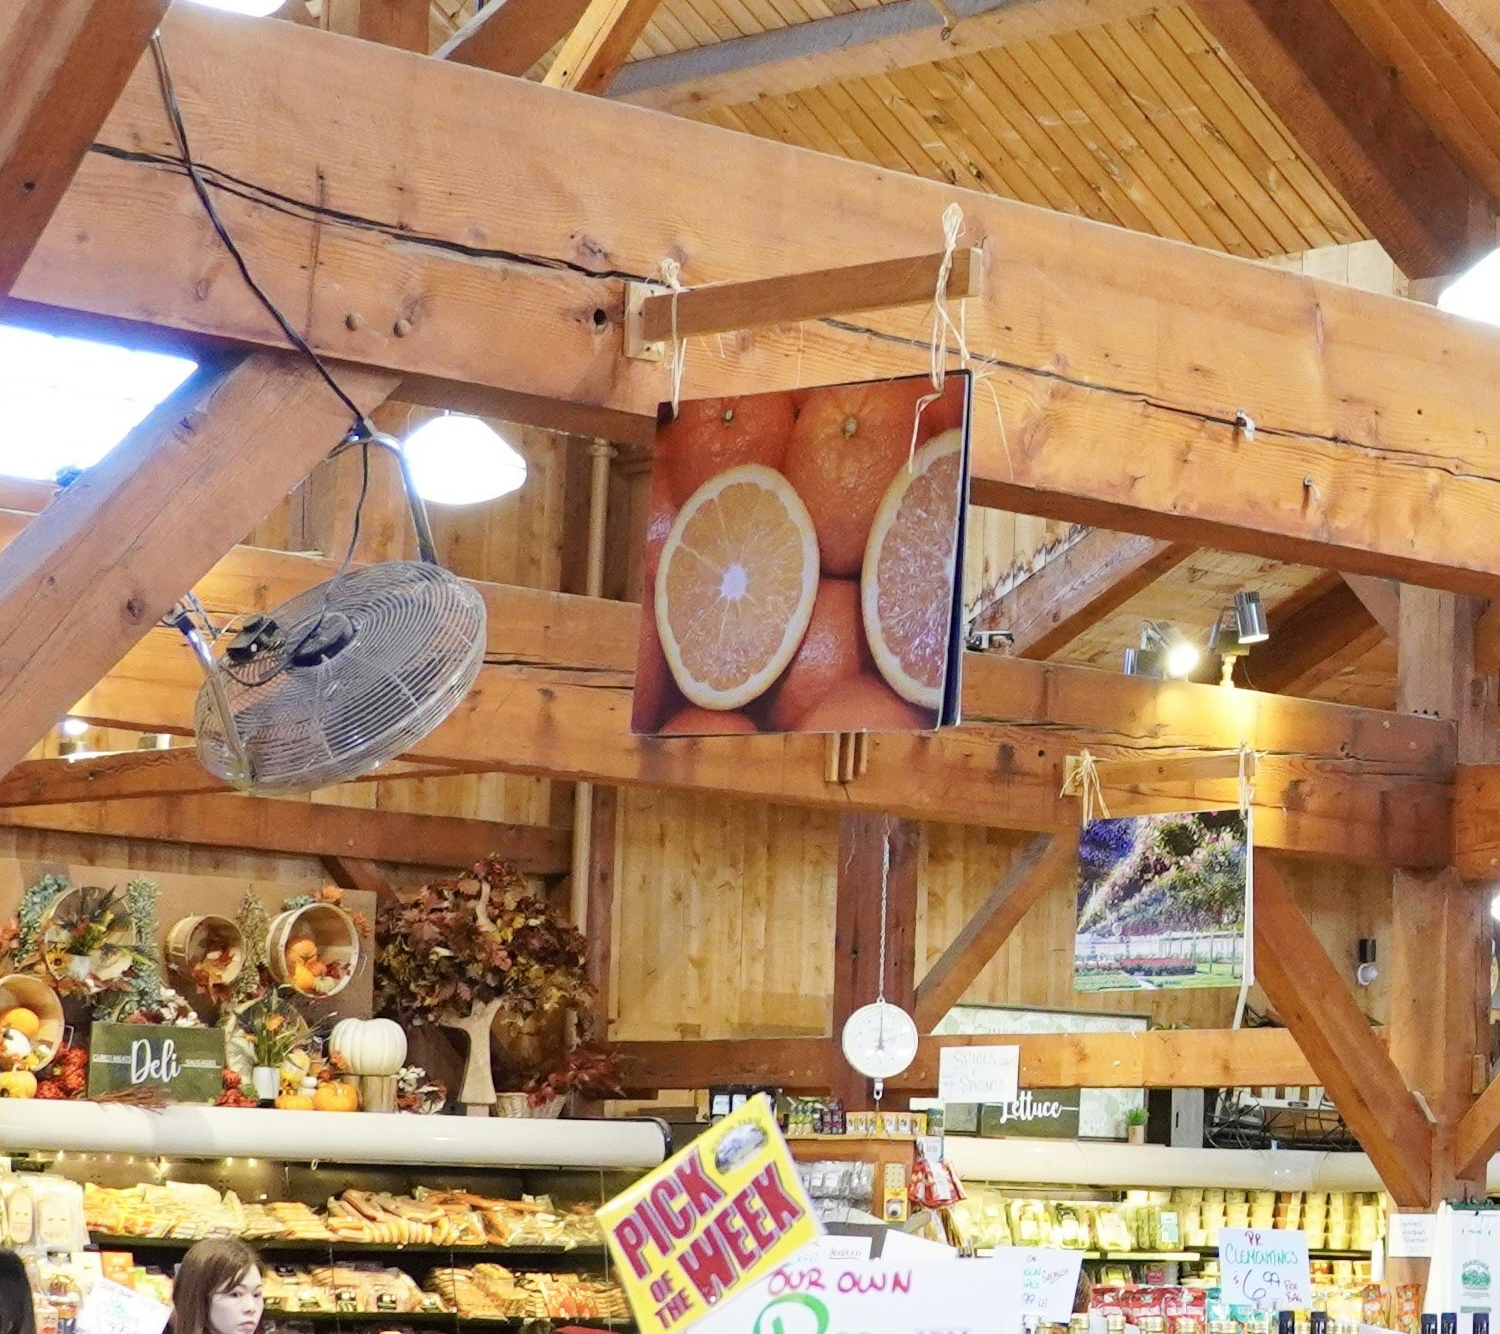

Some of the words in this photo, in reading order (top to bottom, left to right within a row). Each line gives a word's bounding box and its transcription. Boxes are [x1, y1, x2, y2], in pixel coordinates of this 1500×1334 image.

[130, 1038, 181, 1085] Deli
[1000, 1090, 1063, 1124] Lettuce
[613, 1145, 727, 1282] PICK
[677, 1161, 807, 1307] WEEK
[649, 1270, 675, 1304] OF
[767, 1268, 825, 1296] OUR
[837, 1269, 913, 1294] OWN
[655, 1287, 695, 1329] THE
